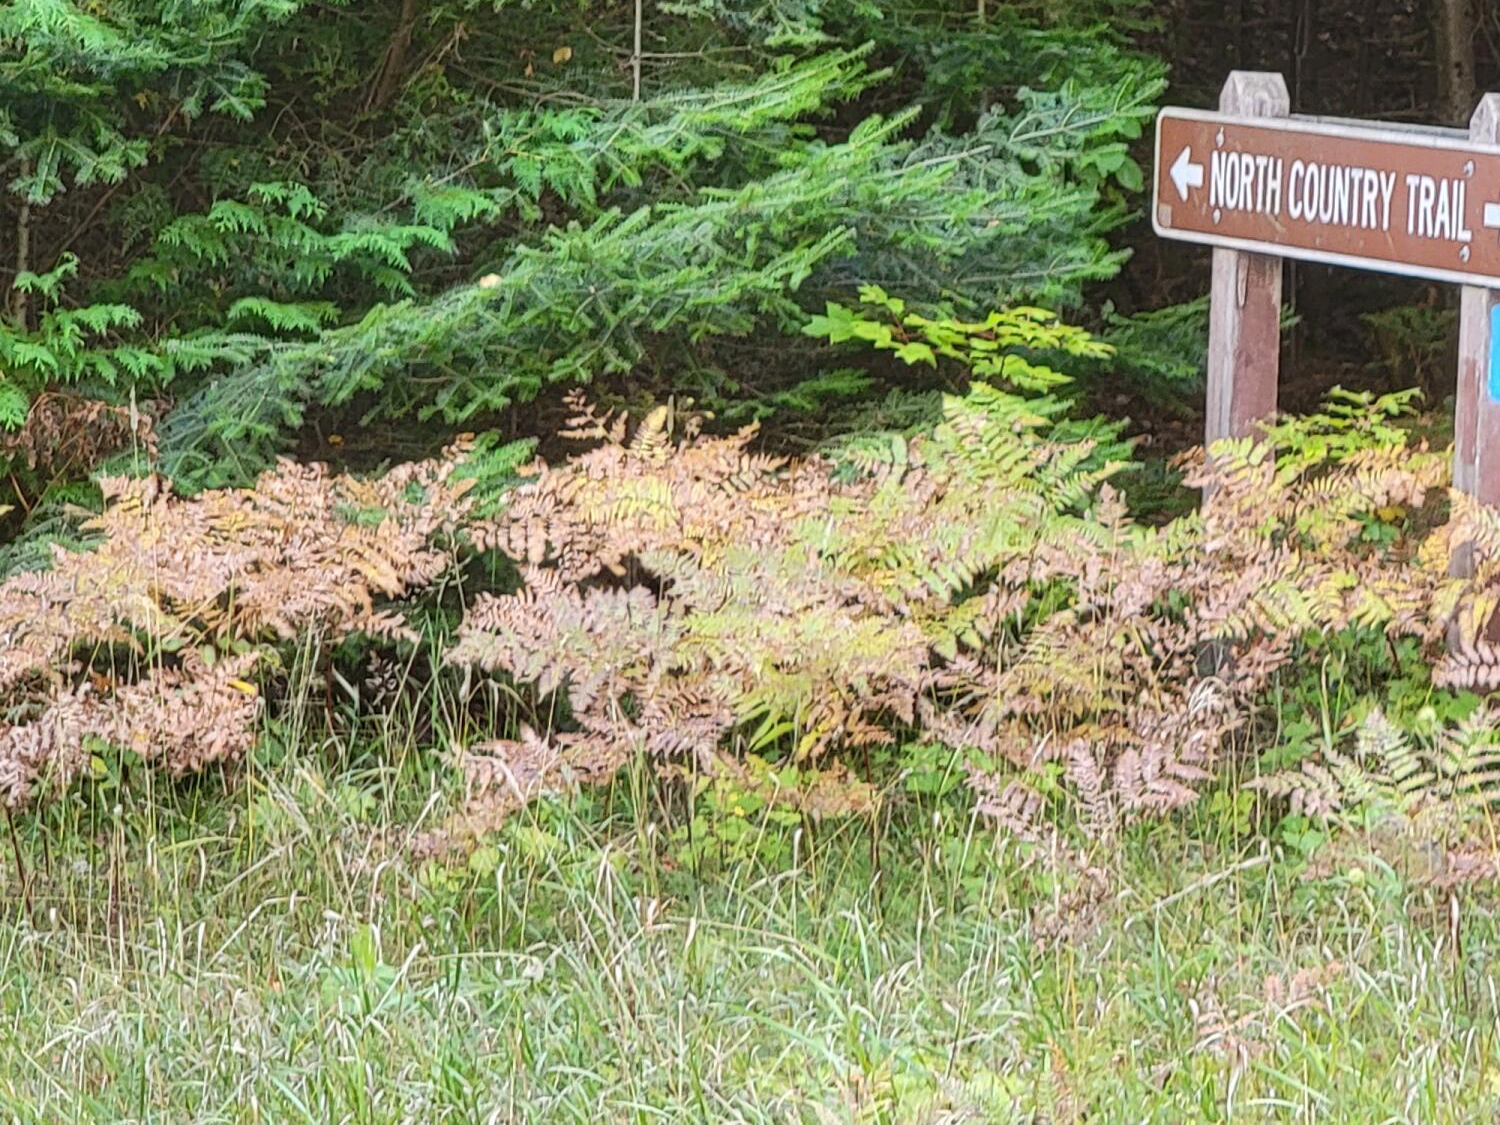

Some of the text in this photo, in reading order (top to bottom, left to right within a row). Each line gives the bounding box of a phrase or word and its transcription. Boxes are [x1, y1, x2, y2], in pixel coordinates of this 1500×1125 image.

[1209, 149, 1472, 242] NORTH COUNTRY TRAIL
